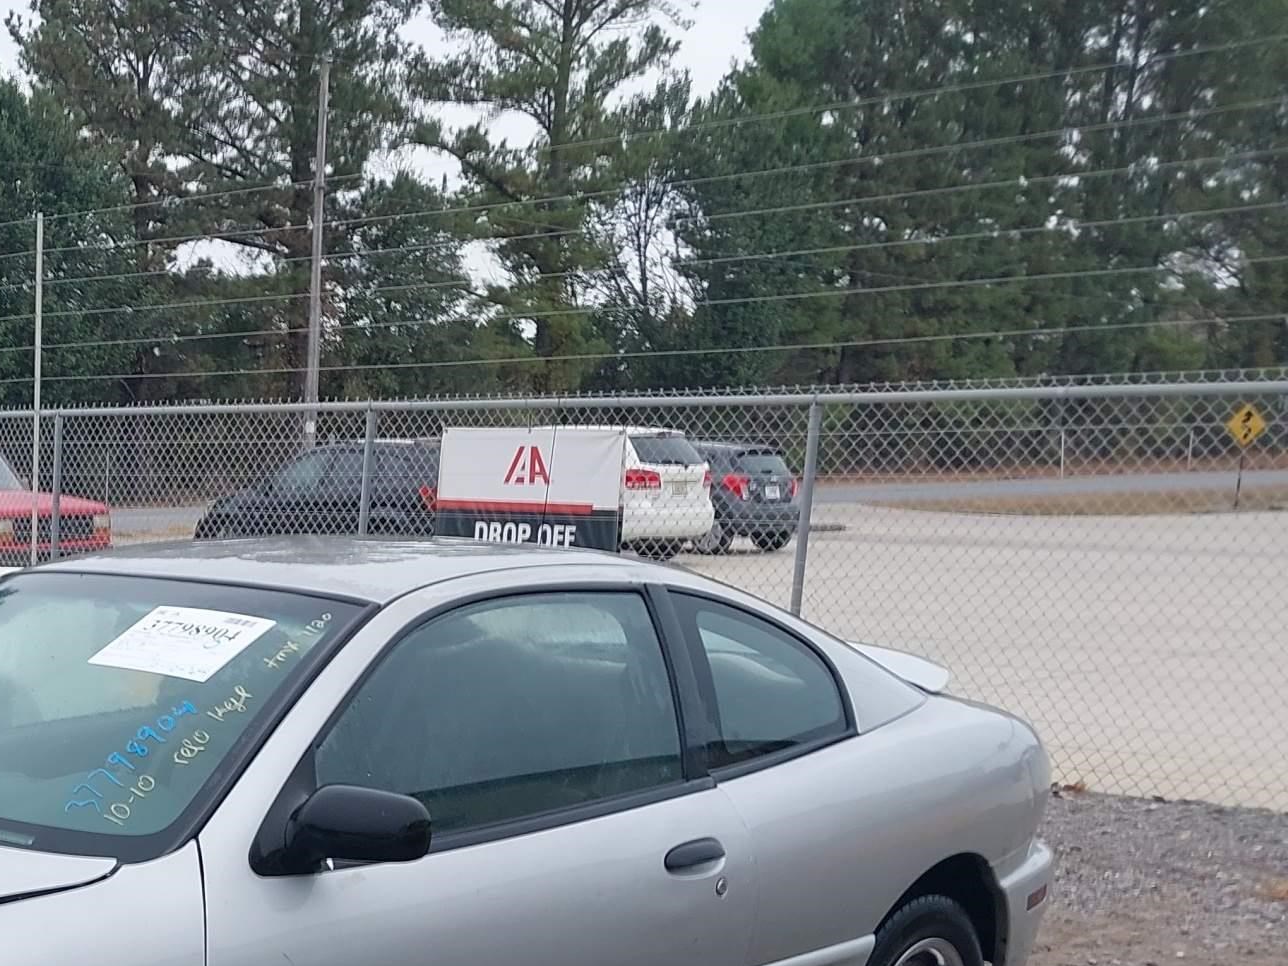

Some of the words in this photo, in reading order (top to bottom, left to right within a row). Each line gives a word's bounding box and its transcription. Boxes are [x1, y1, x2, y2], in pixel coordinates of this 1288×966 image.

[474, 520, 531, 544] DROP
[537, 523, 576, 548] OFF
[143, 619, 243, 643] 37798904
[64, 699, 198, 813] 37798904
[103, 774, 156, 826] 10-10
